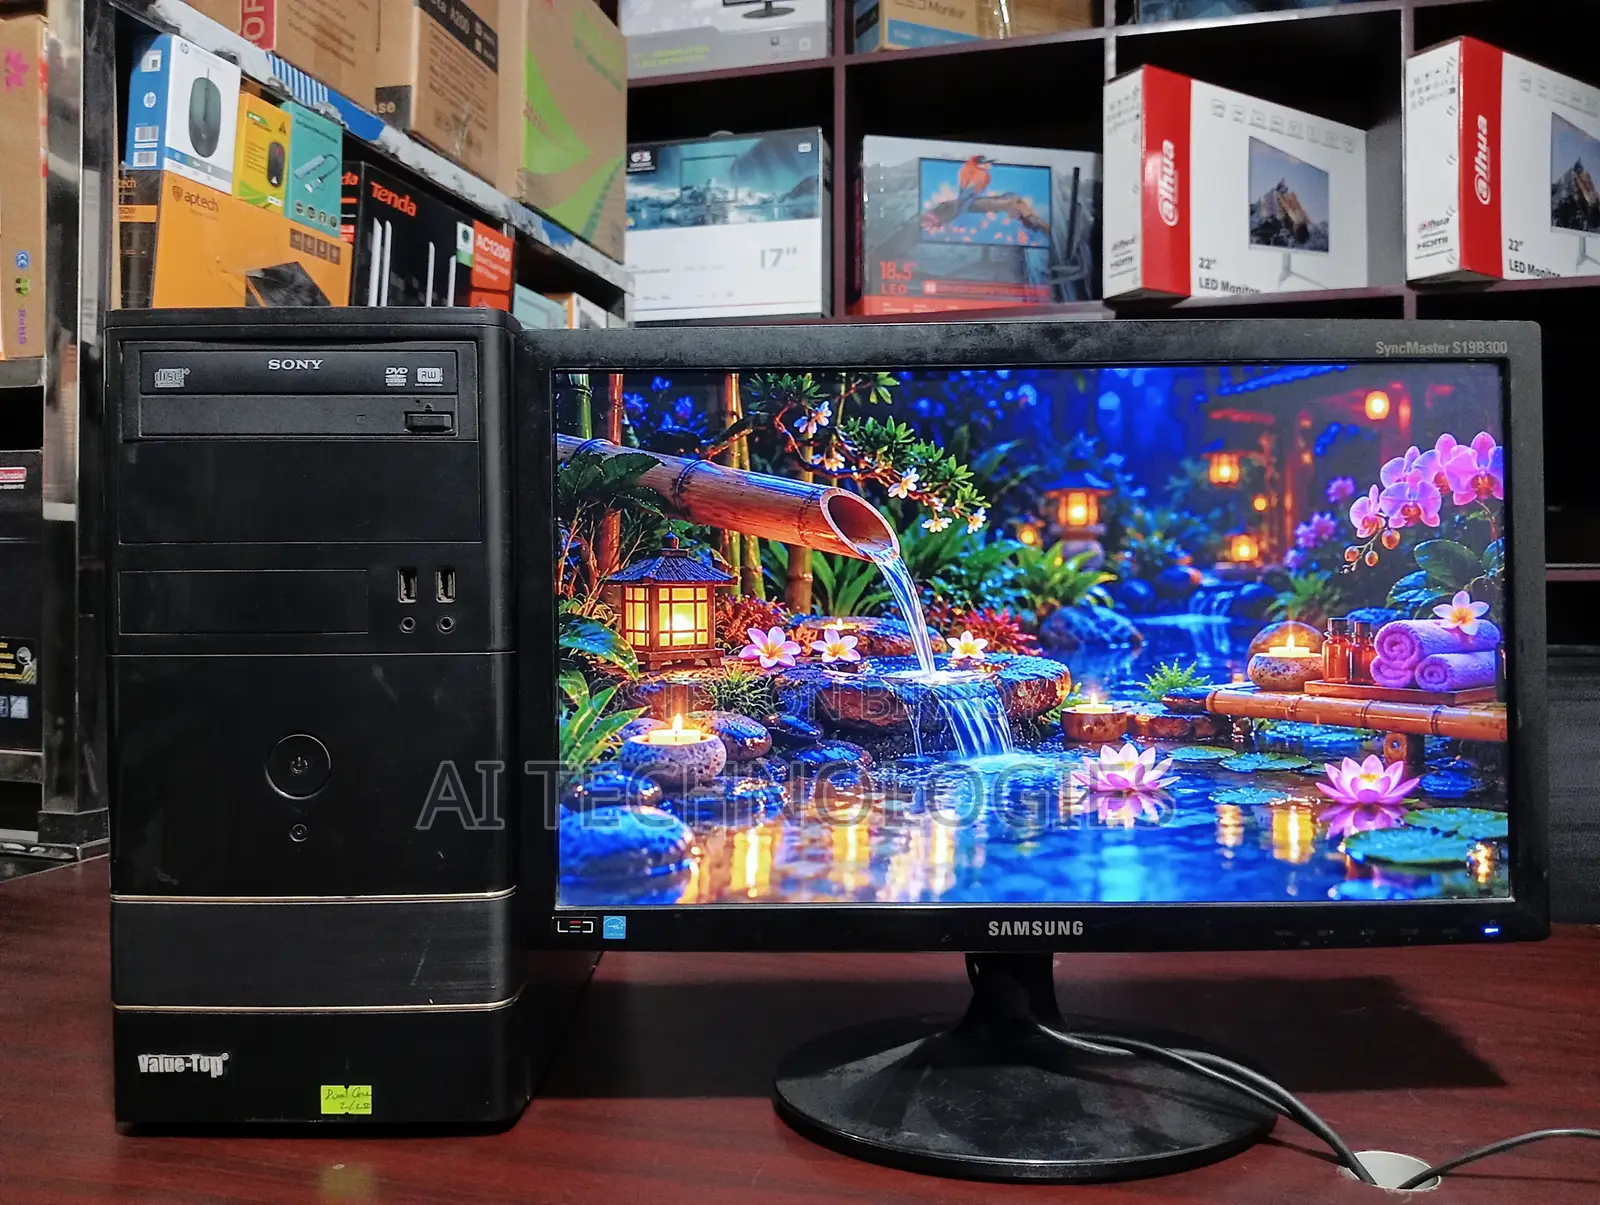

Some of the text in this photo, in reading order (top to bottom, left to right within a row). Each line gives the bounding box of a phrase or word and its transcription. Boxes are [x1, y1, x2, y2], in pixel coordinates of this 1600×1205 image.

[927, 0, 966, 18] Monitor
[184, 190, 220, 213] aptech
[370, 180, 417, 217] Tenda
[1508, 259, 1526, 274] LED
[1198, 277, 1219, 290] LED
[1375, 341, 1509, 357] SyncMaster S19B300
[268, 359, 323, 370] SONY
[385, 367, 409, 375] DVD
[557, 920, 594, 934] LED
[988, 920, 1084, 937] SAMSUNG
